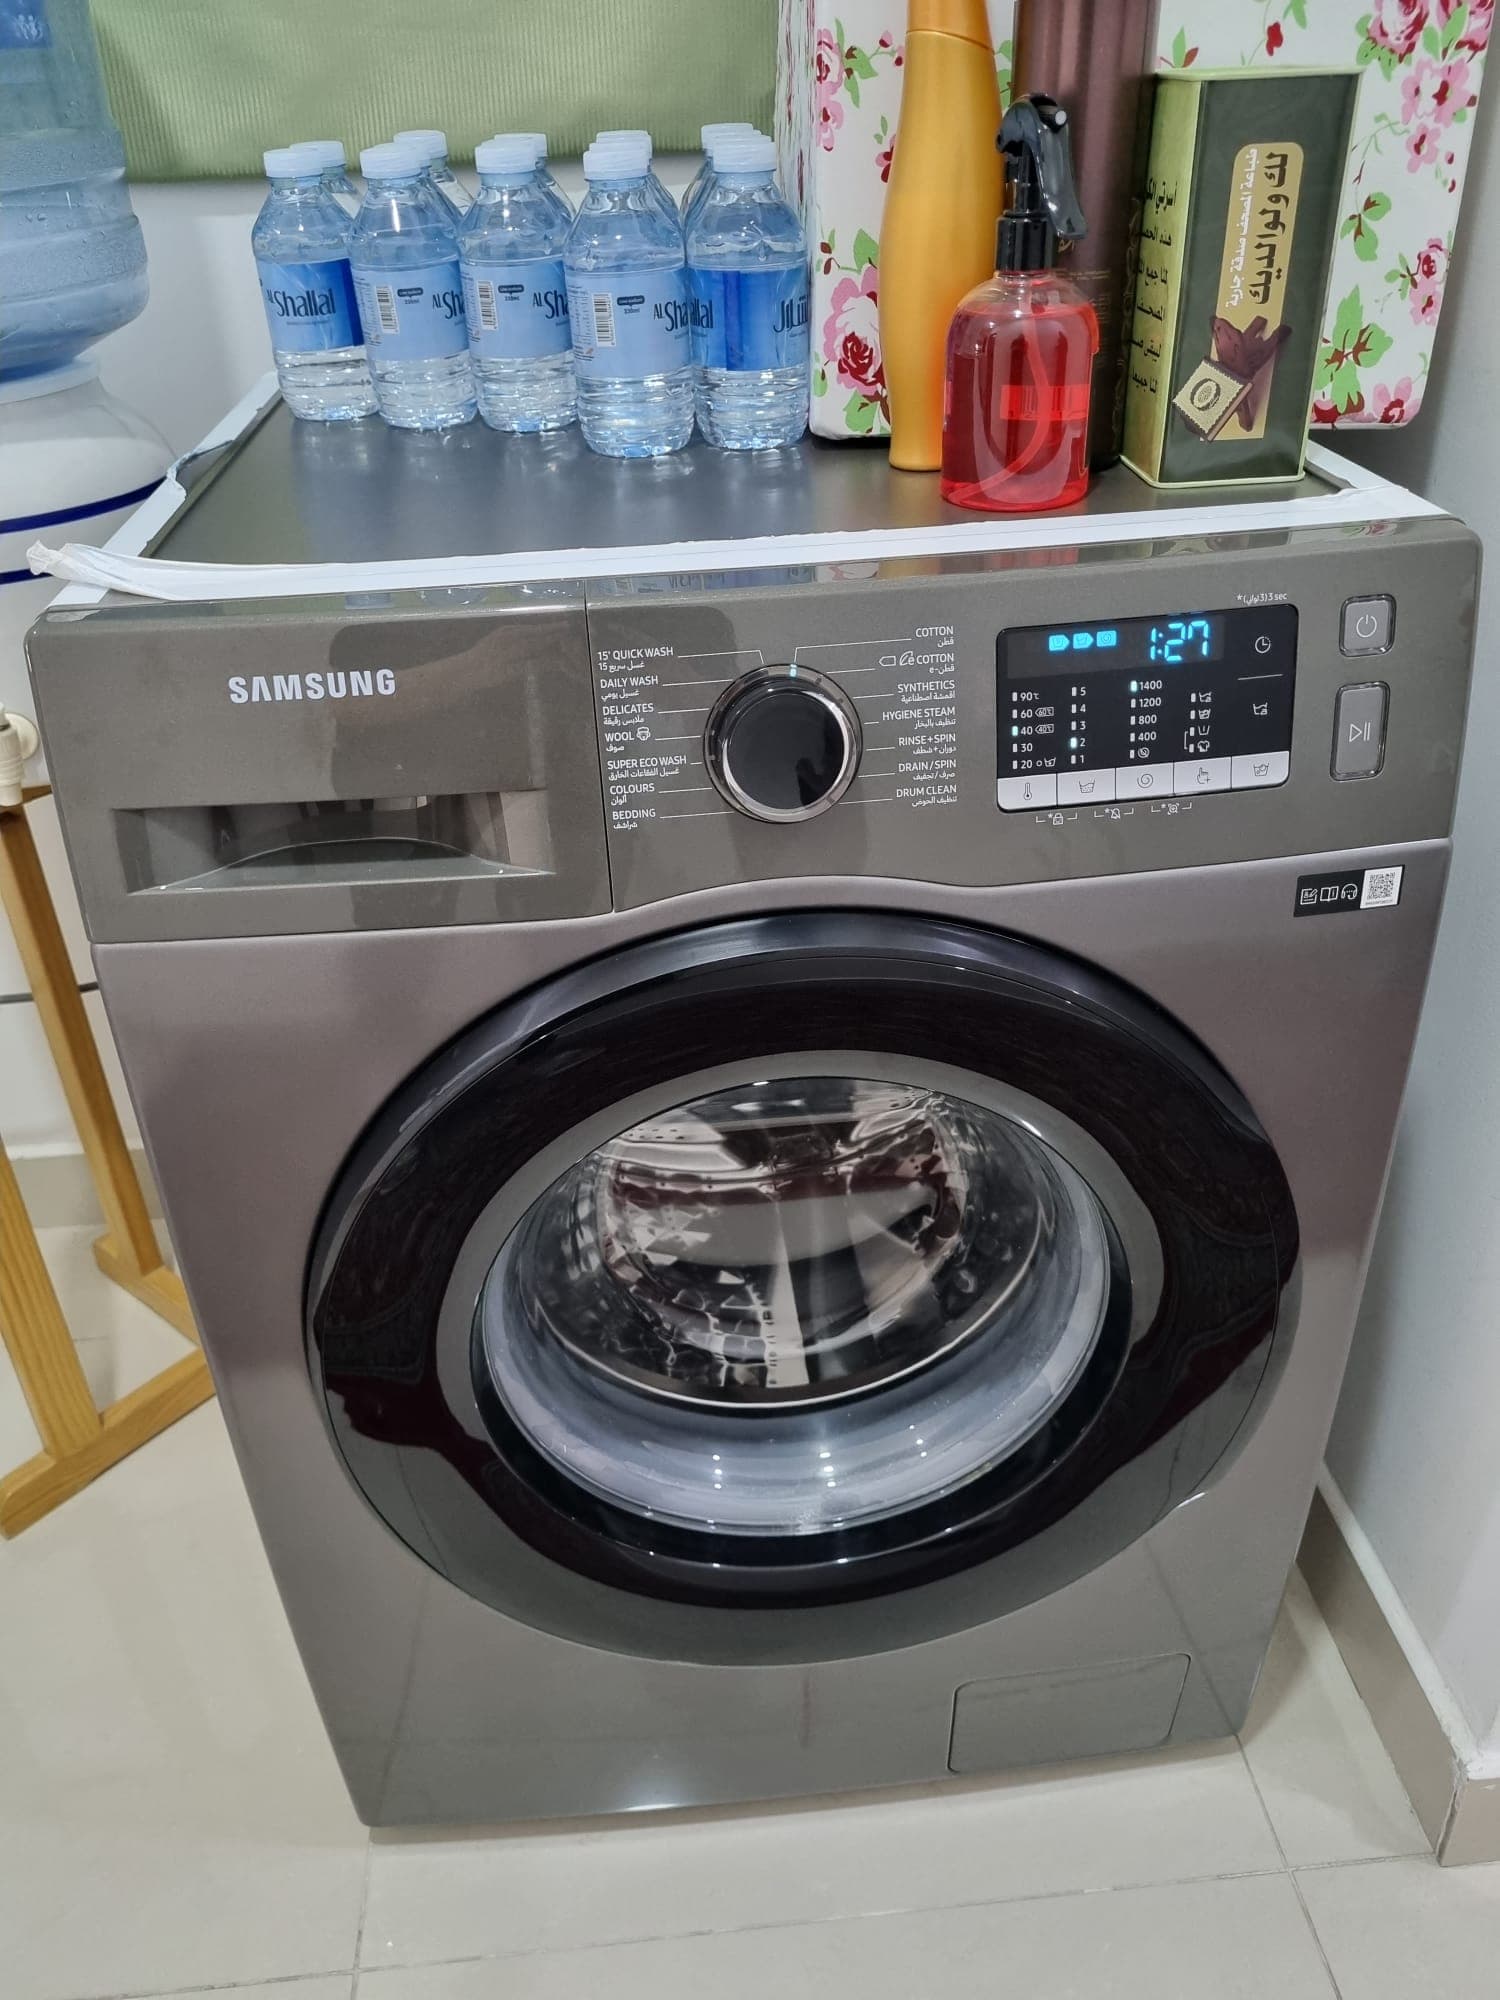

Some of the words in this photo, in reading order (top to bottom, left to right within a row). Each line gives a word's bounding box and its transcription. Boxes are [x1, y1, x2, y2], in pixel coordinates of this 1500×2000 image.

[1240, 148, 1259, 190] طباعة
[1264, 152, 1289, 188] لك
[1236, 193, 1253, 236] المصحف
[1230, 237, 1247, 273] صدقة
[1226, 274, 1245, 309] جارية
[274, 287, 337, 317] Shallal
[915, 626, 954, 637] COTTON
[937, 636, 954, 647] قطن
[1150, 620, 1209, 662] 1:27
[612, 648, 644, 661] QUICK
[644, 646, 674, 658] WASH
[916, 652, 954, 664] COTTON
[598, 662, 608, 671] 15
[228, 668, 396, 704] SAMSUNG
[600, 677, 628, 689] DAILY
[630, 675, 659, 687] WASH
[897, 680, 956, 694] SYNTHETICS
[1139, 680, 1163, 691] 1400
[1080, 686, 1086, 697] 5
[1080, 703, 1086, 713] 4
[1139, 697, 1162, 708] 1200
[602, 703, 654, 716] DELICATES
[882, 708, 923, 721] HYGIENE
[924, 706, 956, 718] STEAM
[1020, 708, 1033, 719] 60
[1080, 720, 1086, 730] 3
[1138, 714, 1157, 725] 800
[605, 731, 635, 742] WOOL
[1020, 725, 1033, 736] 40
[1138, 731, 1157, 742] 400
[1020, 742, 1033, 753] 30
[1080, 737, 1086, 747] 2
[607, 759, 638, 770] SUPER
[639, 757, 658, 768] ECO
[659, 755, 687, 766] WASH
[1020, 759, 1033, 769] 20
[609, 783, 655, 795] COLOURS
[896, 786, 925, 798] DRUM
[926, 784, 957, 796] CLEAN
[612, 808, 656, 820] BEDDING
